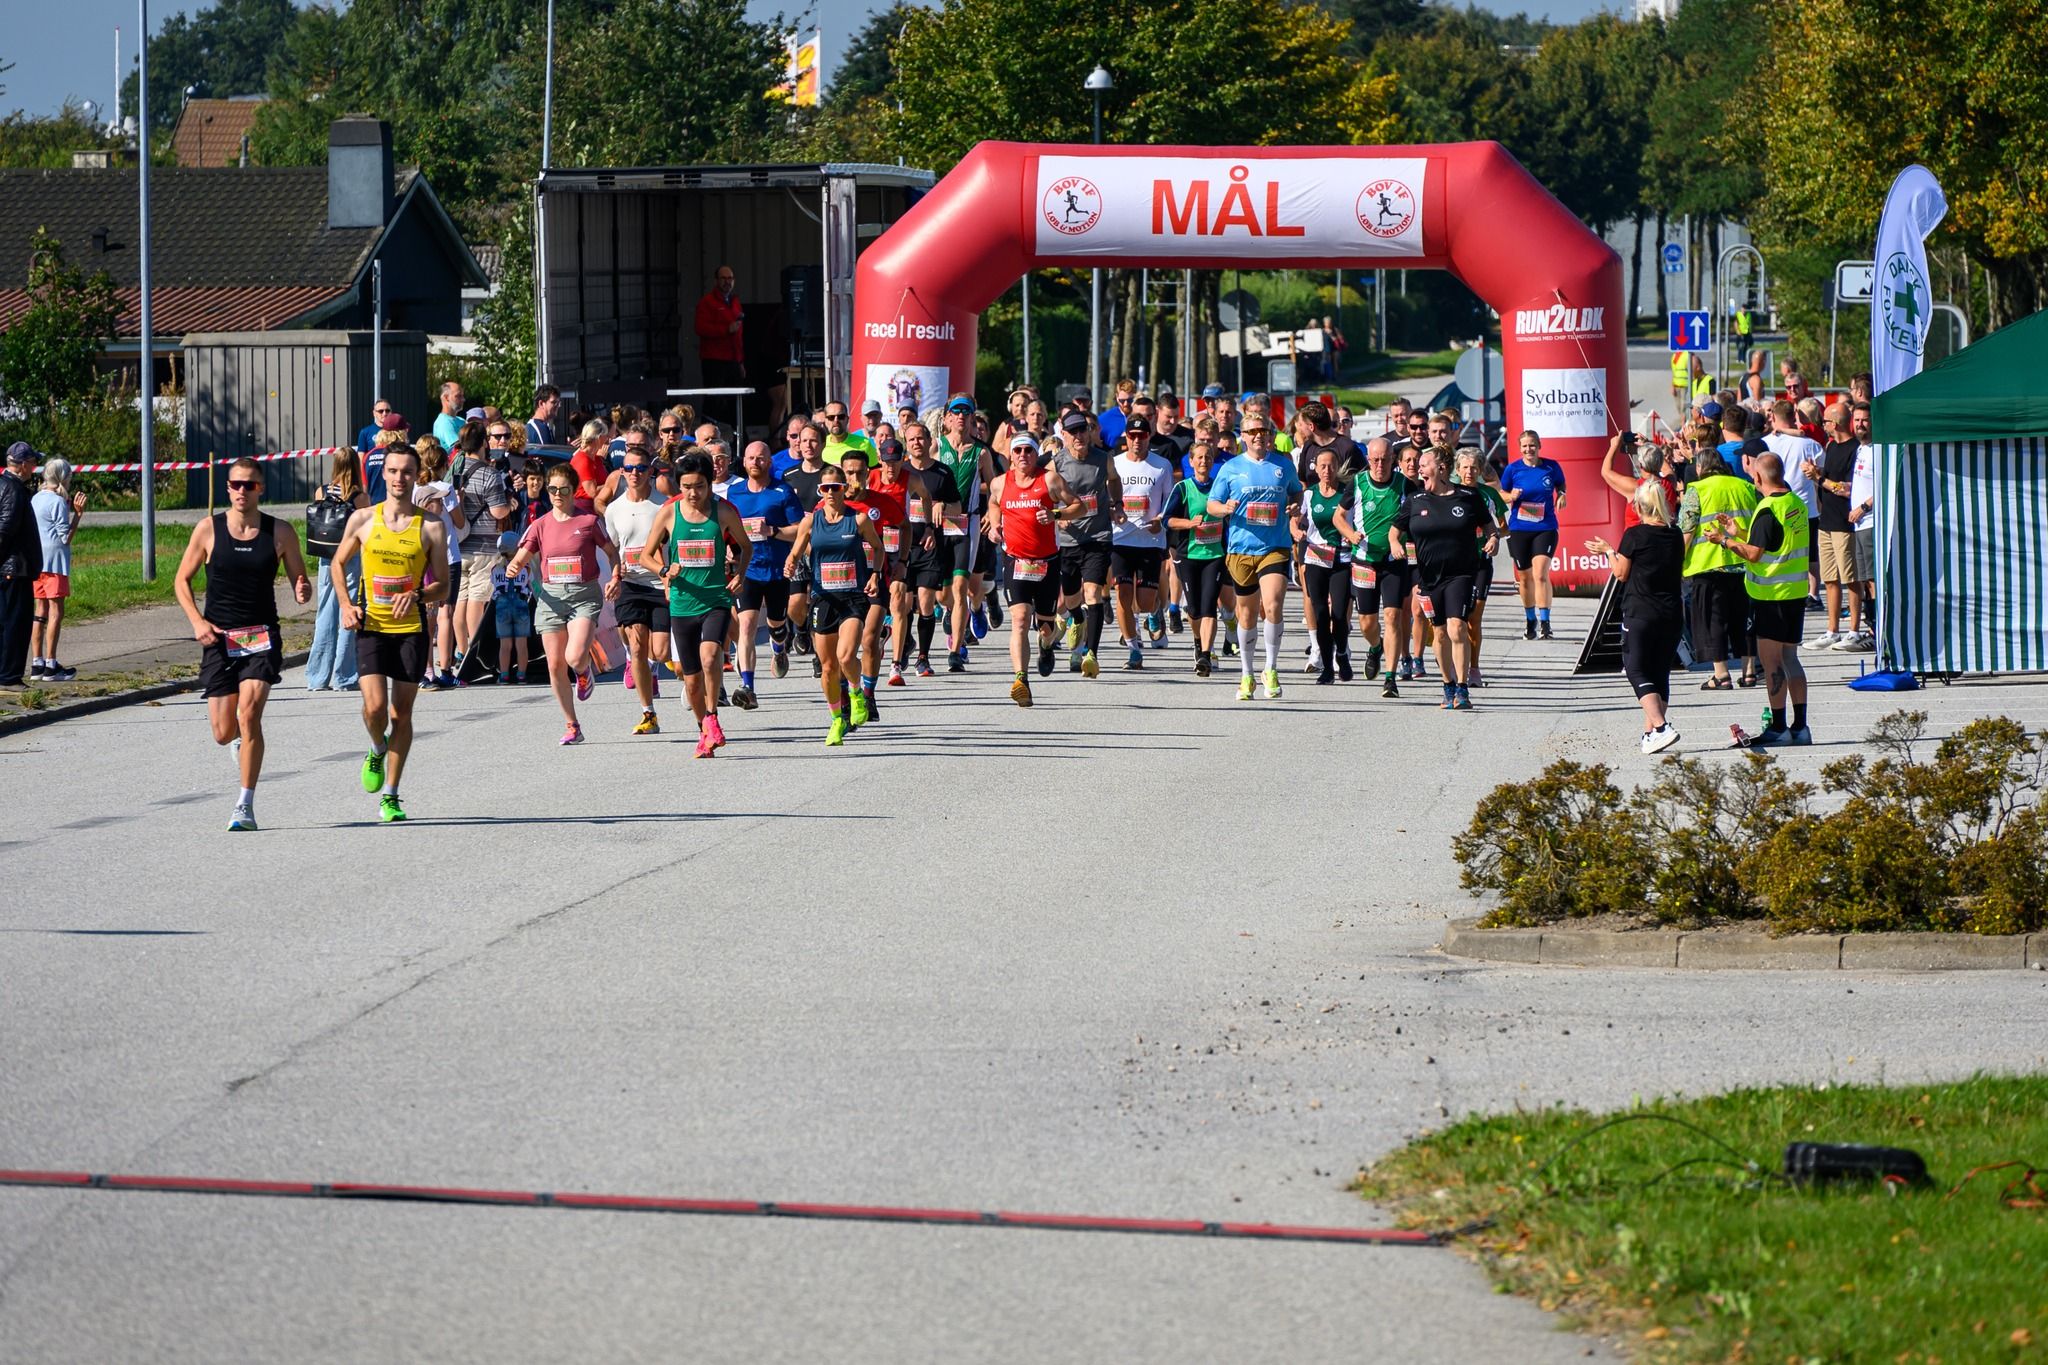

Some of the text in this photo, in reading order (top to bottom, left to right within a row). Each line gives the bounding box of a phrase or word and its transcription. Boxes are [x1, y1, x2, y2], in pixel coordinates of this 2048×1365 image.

[1053, 179, 1096, 196] BOV IF
[1365, 181, 1409, 199] BOV IF
[1152, 165, 1305, 236] MÅL
[1068, 211, 1098, 232] MOTION
[1382, 213, 1411, 236] MOTION
[1515, 304, 1605, 334] RUN2U.DK
[1526, 388, 1602, 408] Sydbank
[1565, 409, 1581, 418] gøre
[1593, 407, 1603, 417] dig
[1121, 476, 1156, 486] USION
[1006, 499, 1041, 509] DANMARK
